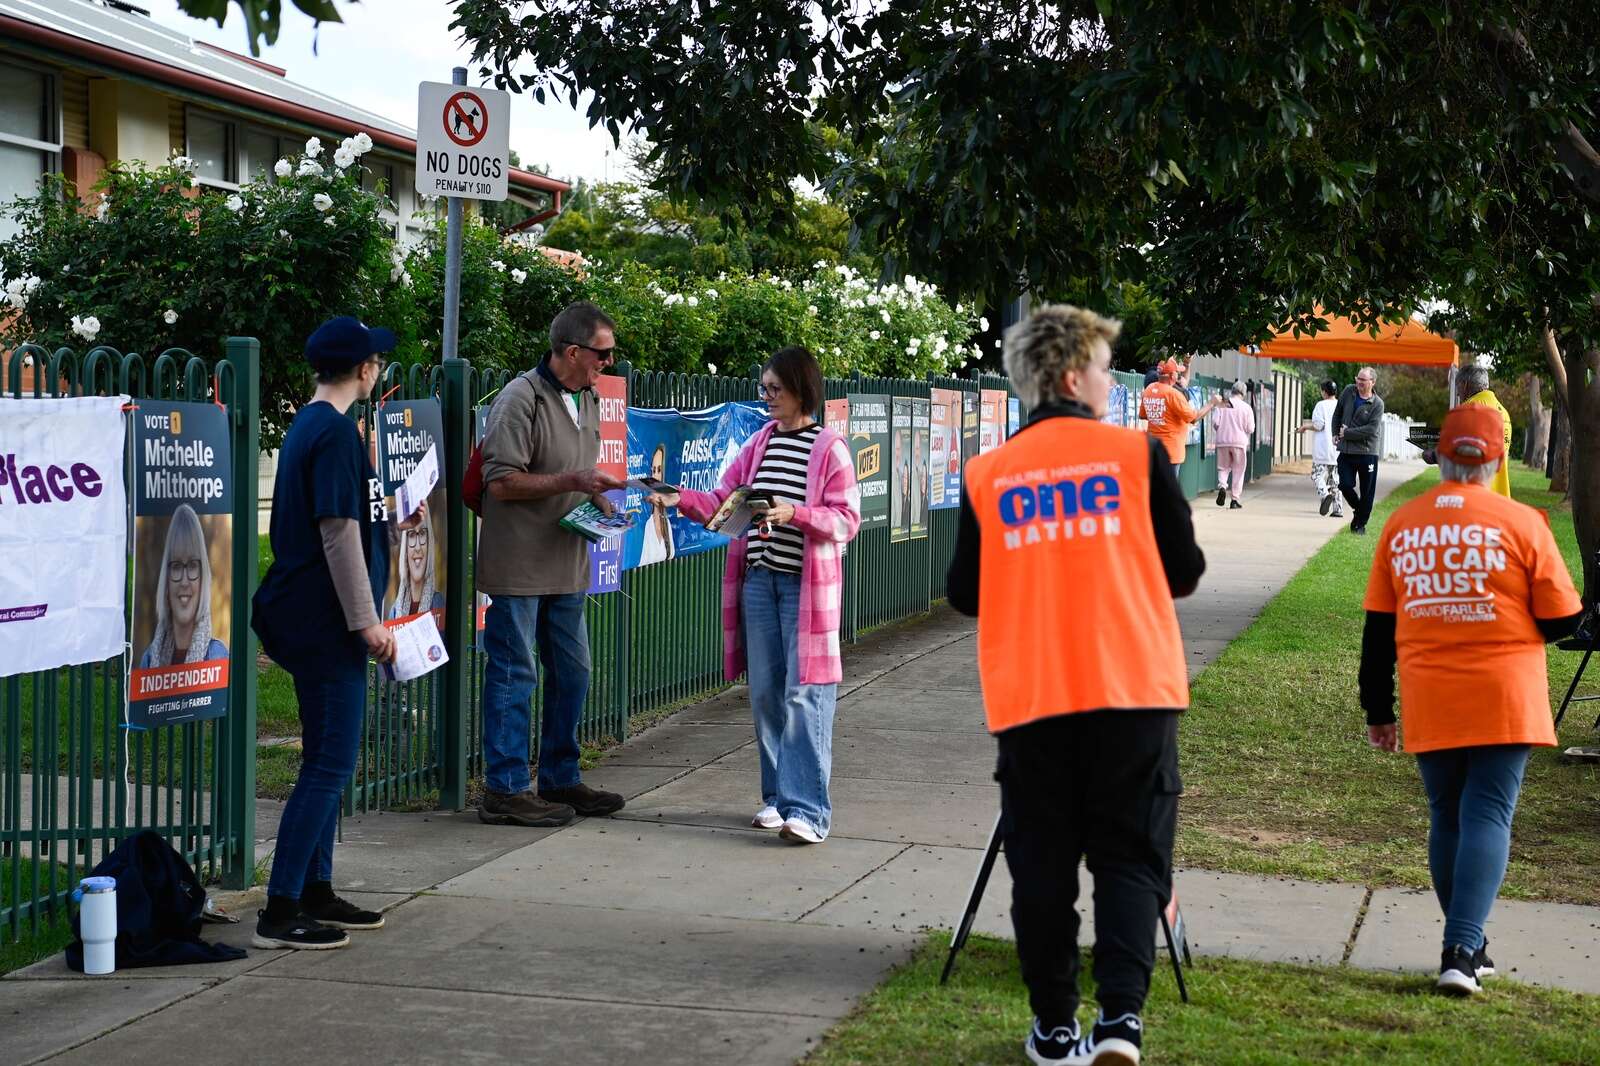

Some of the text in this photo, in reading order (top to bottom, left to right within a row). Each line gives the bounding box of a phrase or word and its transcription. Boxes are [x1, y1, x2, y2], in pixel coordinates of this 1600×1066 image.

[427, 151, 501, 178] NO DOGS
[436, 179, 473, 192] PENALTY
[144, 415, 169, 429] VOTE
[386, 413, 404, 425] VOTE
[599, 398, 625, 422] RENTS
[145, 436, 214, 467] Michelle
[387, 429, 433, 456] Michelle
[596, 439, 624, 464] ATTER
[681, 439, 714, 463] RAISSA
[859, 449, 873, 475] VOTE
[145, 468, 223, 504] Milthorpe
[998, 474, 1120, 528] one
[1004, 516, 1121, 550] NATION
[1390, 524, 1501, 553] CHANGE
[598, 560, 618, 586] First
[1391, 547, 1506, 576] YOU CAN
[1404, 572, 1488, 596] TRUST
[140, 666, 221, 693] INDEPENDENT
[148, 701, 180, 714] FIGHTING
[188, 696, 212, 708] FARRER
